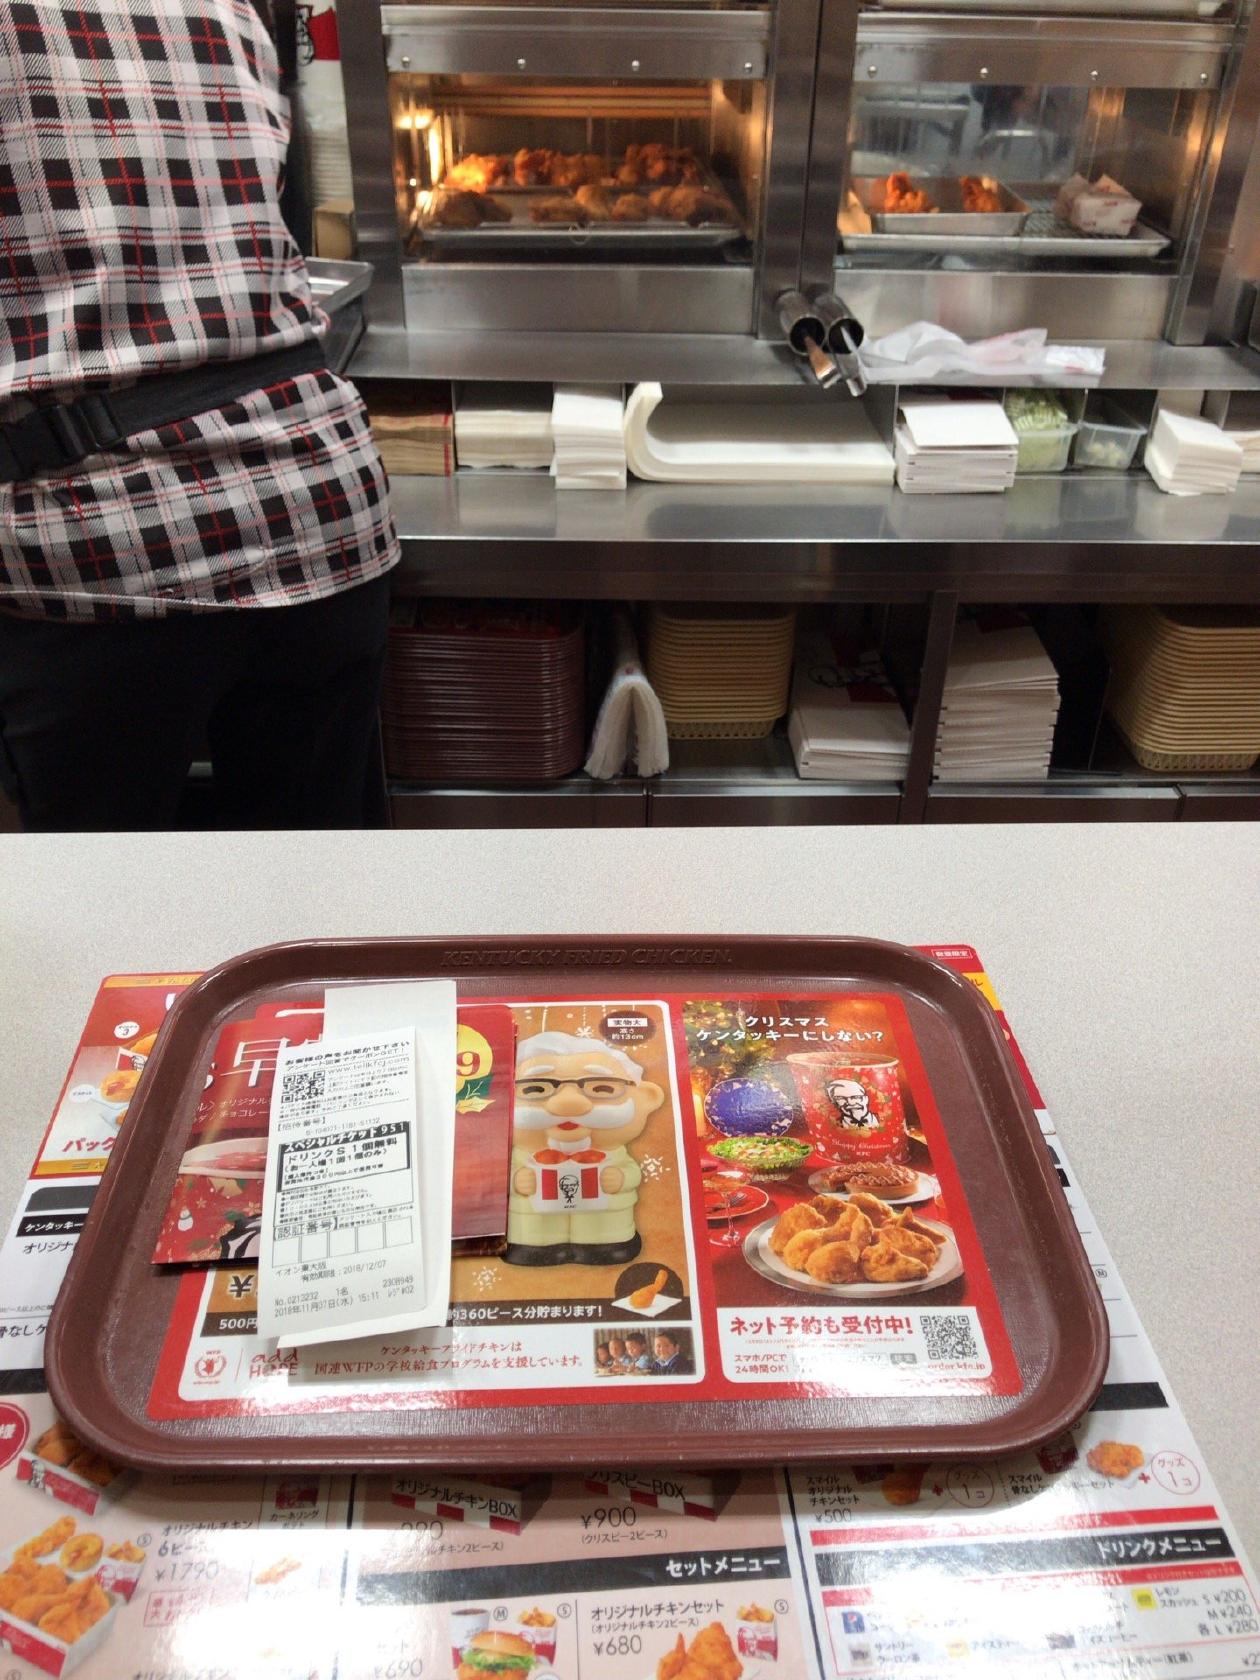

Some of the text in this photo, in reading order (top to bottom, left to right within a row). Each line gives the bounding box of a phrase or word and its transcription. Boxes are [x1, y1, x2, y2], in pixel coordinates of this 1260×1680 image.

[440, 949, 561, 967] KENTUCKY
[563, 948, 627, 966] FRIED
[744, 1015, 829, 1028] クリスマス
[696, 1029, 884, 1042] ケンタッキーにしない?
[24, 1221, 86, 1233] ケンタッキー
[23, 1241, 78, 1255] オリジナ
[729, 1315, 914, 1336] ネット予約も受付中!
[251, 1347, 299, 1364] add
[379, 1342, 522, 1357] ケンタッキーフライドチキンは
[805, 1475, 841, 1486] スマイル
[394, 1478, 519, 1519] オリジナルチキンBOX
[807, 1484, 853, 1497] オリジナル
[809, 1494, 861, 1507] チキンセット
[580, 1506, 637, 1530] ¥900
[814, 1507, 853, 1524] ¥500
[580, 1529, 669, 1546] (クリスピー2ピース)
[1095, 1536, 1223, 1562] ドリンクメニュー
[154, 1560, 220, 1583] ¥1790
[665, 1555, 782, 1580] セットメニュー
[1213, 1588, 1248, 1604] ¥200
[590, 1598, 726, 1622] オリジナルチキンセット
[1206, 1604, 1254, 1621] M ¥240
[590, 1616, 701, 1635] (オリジナルチキン2ピース)
[1226, 1620, 1260, 1636] ¥280
[592, 1633, 643, 1658] ¥680
